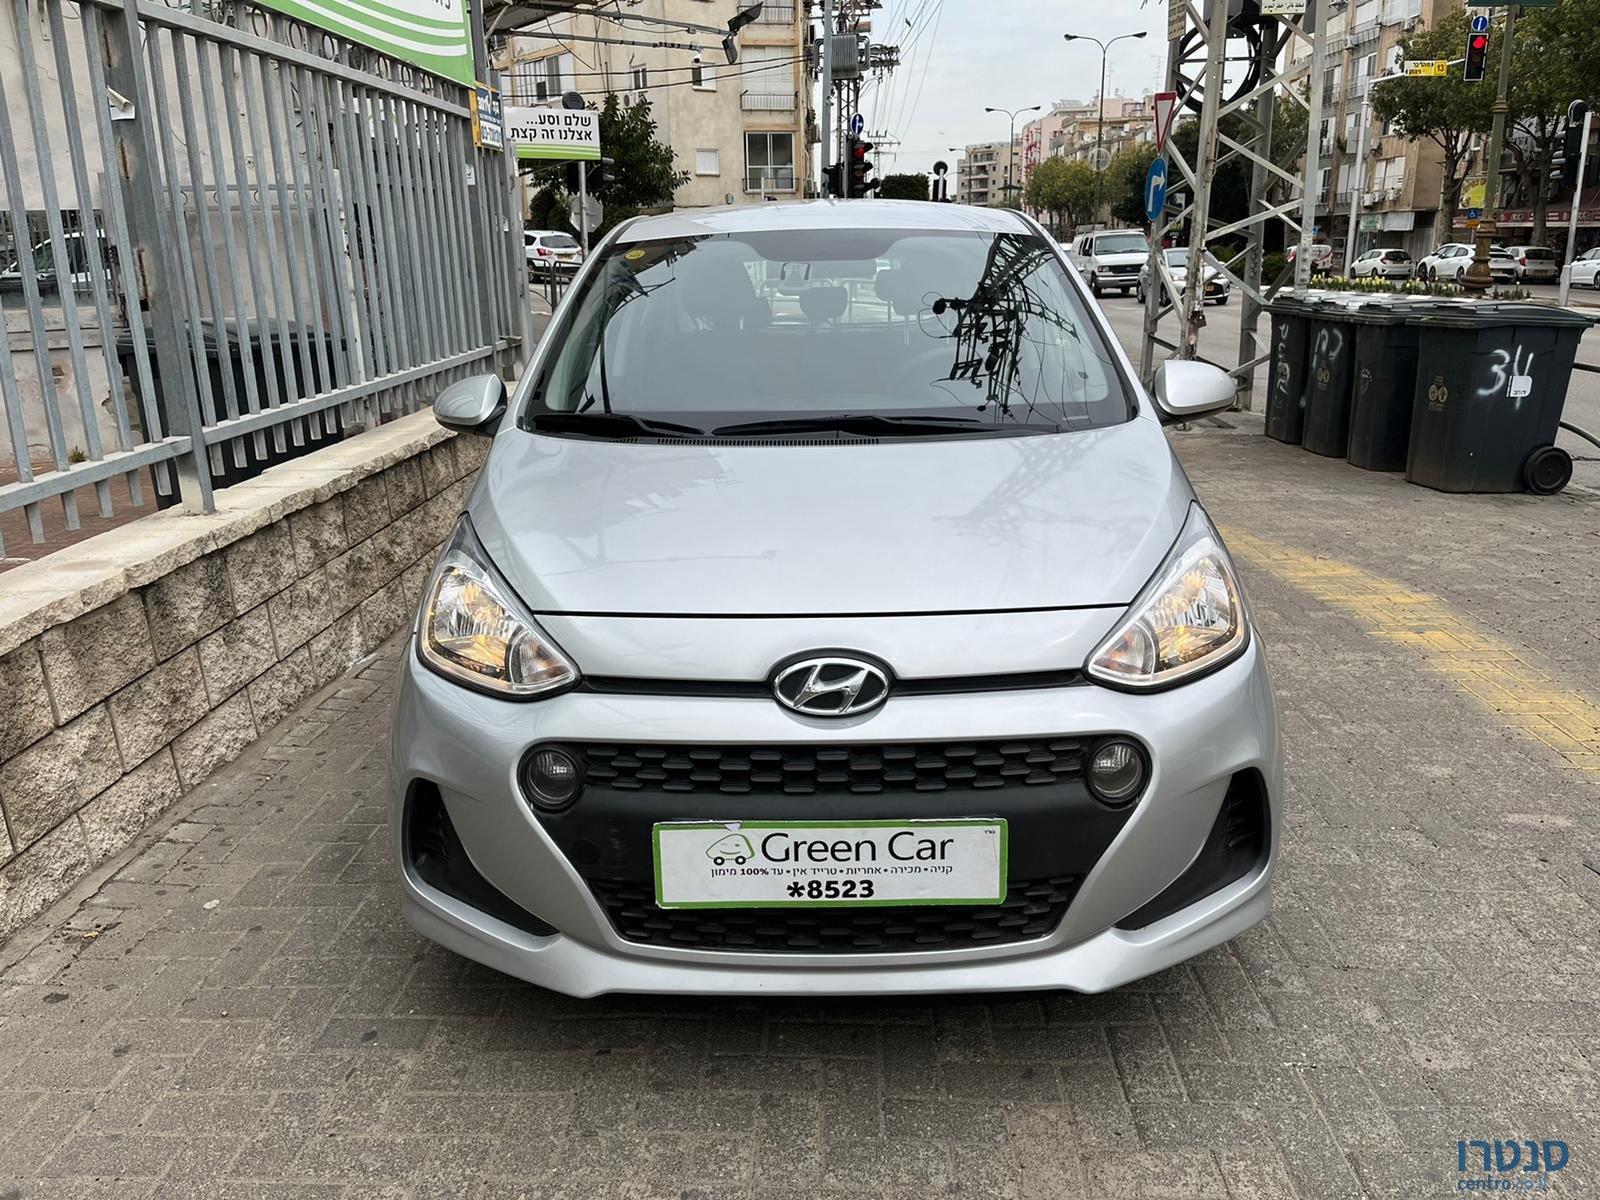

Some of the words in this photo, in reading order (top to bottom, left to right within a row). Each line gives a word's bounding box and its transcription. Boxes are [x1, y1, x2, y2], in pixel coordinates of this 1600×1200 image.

[526, 114, 560, 126] וסע...
[564, 113, 591, 126] שלם
[511, 127, 537, 142] קצת
[541, 128, 554, 140] זה
[559, 128, 592, 141] אצלנו
[761, 833, 877, 863] Green
[888, 831, 954, 861] Car
[711, 867, 737, 878] מימון
[741, 867, 769, 876] 100%
[771, 867, 784, 876] עד
[793, 867, 808, 877] אין
[811, 867, 838, 876] טרייד
[846, 866, 882, 875] אחריות
[890, 866, 921, 874] מכירה
[930, 865, 953, 875] קניה
